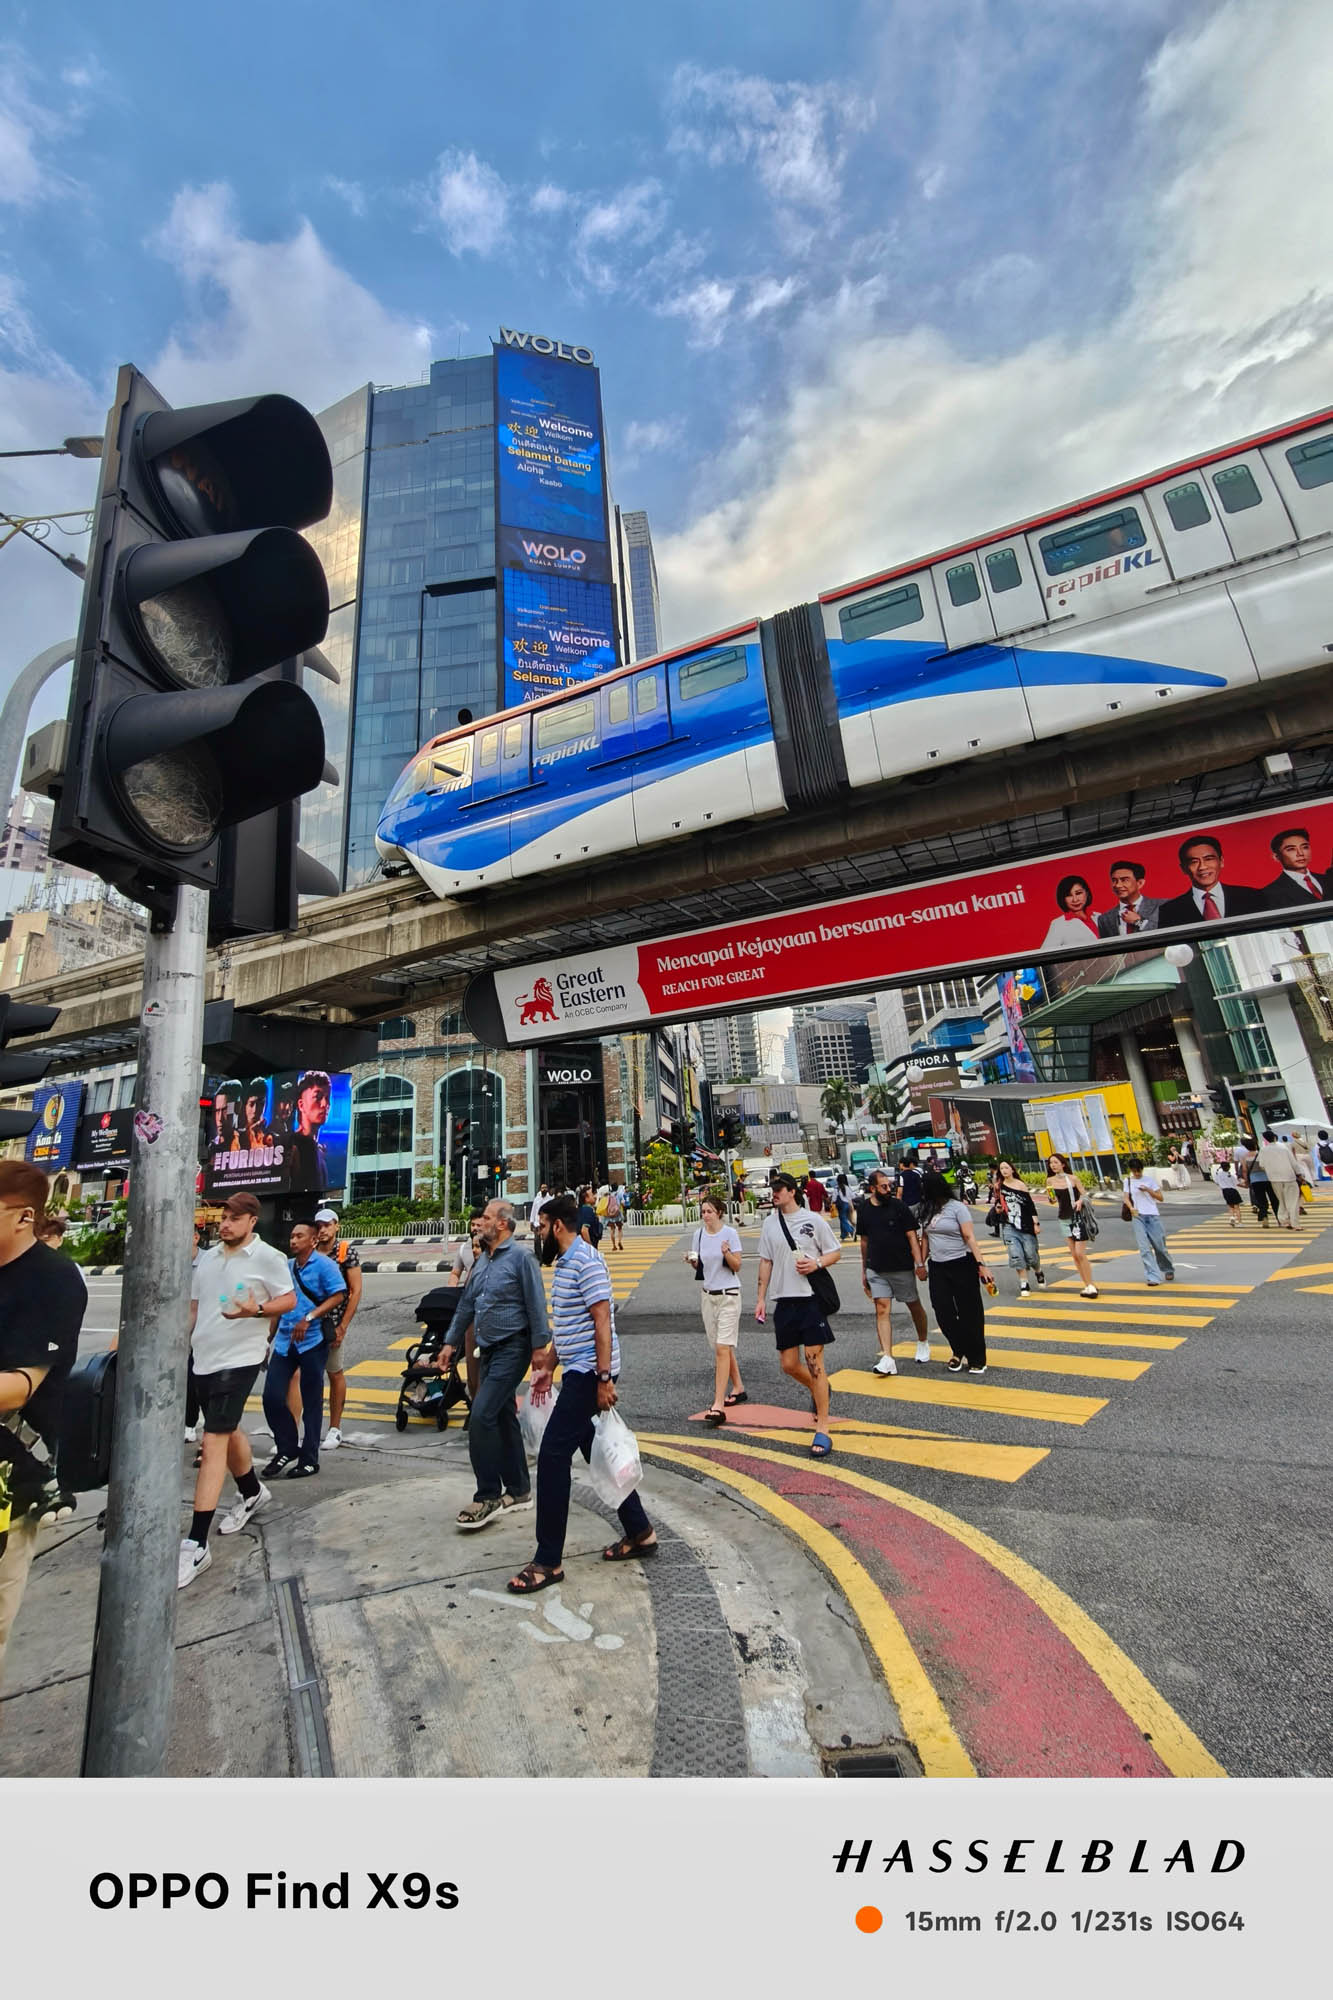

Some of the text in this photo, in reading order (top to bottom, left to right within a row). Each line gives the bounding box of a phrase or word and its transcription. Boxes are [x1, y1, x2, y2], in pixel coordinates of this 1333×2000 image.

[500, 327, 594, 365] WOLO
[507, 422, 540, 438] 欢迎
[538, 418, 593, 439] Welcome
[544, 430, 574, 442] Welkom
[507, 446, 552, 463] Selamat
[554, 456, 592, 472] Datang
[517, 463, 544, 475] Aloha
[522, 540, 586, 564] WOLO
[553, 562, 581, 570] LUMPUR
[1045, 549, 1162, 598] rapidKL
[512, 637, 550, 656] 欢迎
[549, 630, 611, 648] Welcome
[554, 645, 588, 656] Welkom
[513, 670, 563, 686] Selamat
[533, 735, 600, 768] rapidKL
[656, 884, 1025, 973] Mencapai Kejayaan bersama-sama kami
[556, 966, 606, 991] Great
[661, 966, 766, 997] REACH FOR GREAT
[559, 983, 626, 1009] Eastern
[564, 1002, 628, 1019] An OCBC Company
[906, 1054, 950, 1067] SEPHORA
[547, 1069, 592, 1082] WOLO
[221, 1145, 284, 1171] FURIOUS
